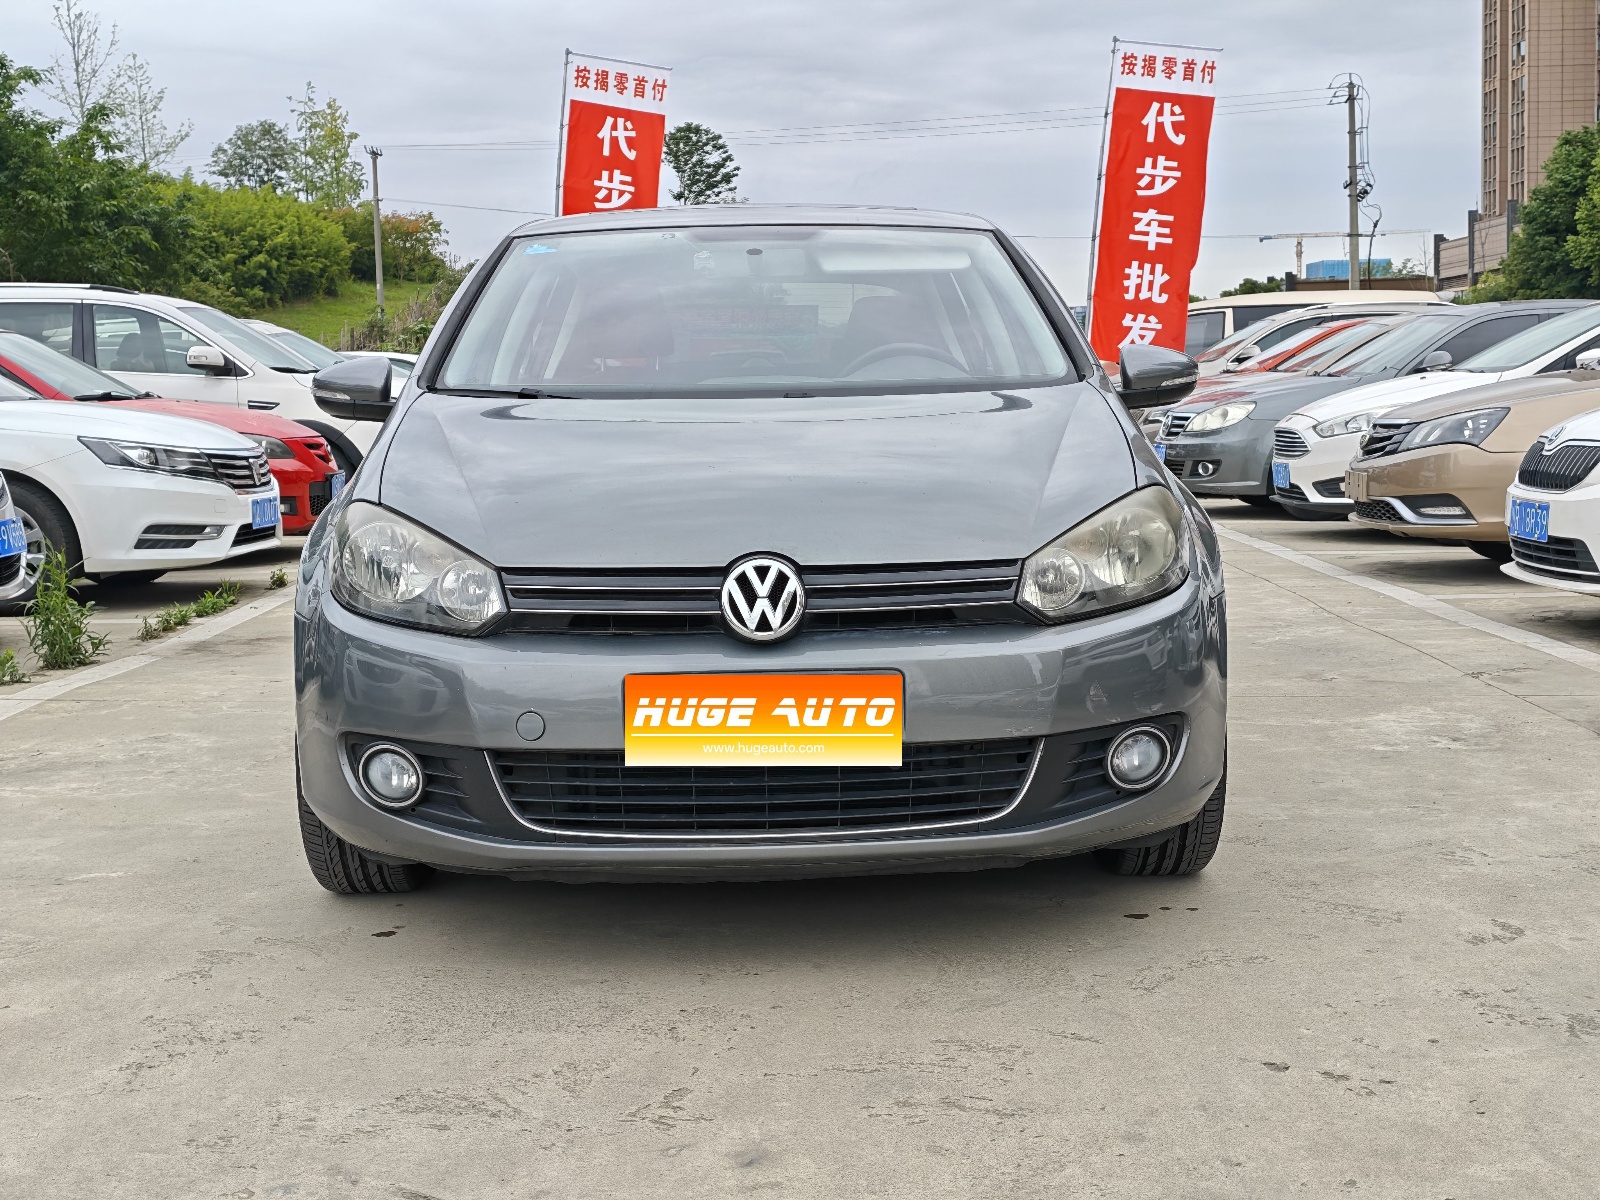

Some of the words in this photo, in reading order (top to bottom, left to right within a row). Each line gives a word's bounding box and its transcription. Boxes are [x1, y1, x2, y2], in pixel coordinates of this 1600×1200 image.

[573, 64, 668, 102] 按揭零首付
[1120, 51, 1216, 84] 按揭零首付
[593, 115, 637, 209] 代步
[1117, 101, 1186, 348] 代步车批发
[723, 560, 803, 635] VW
